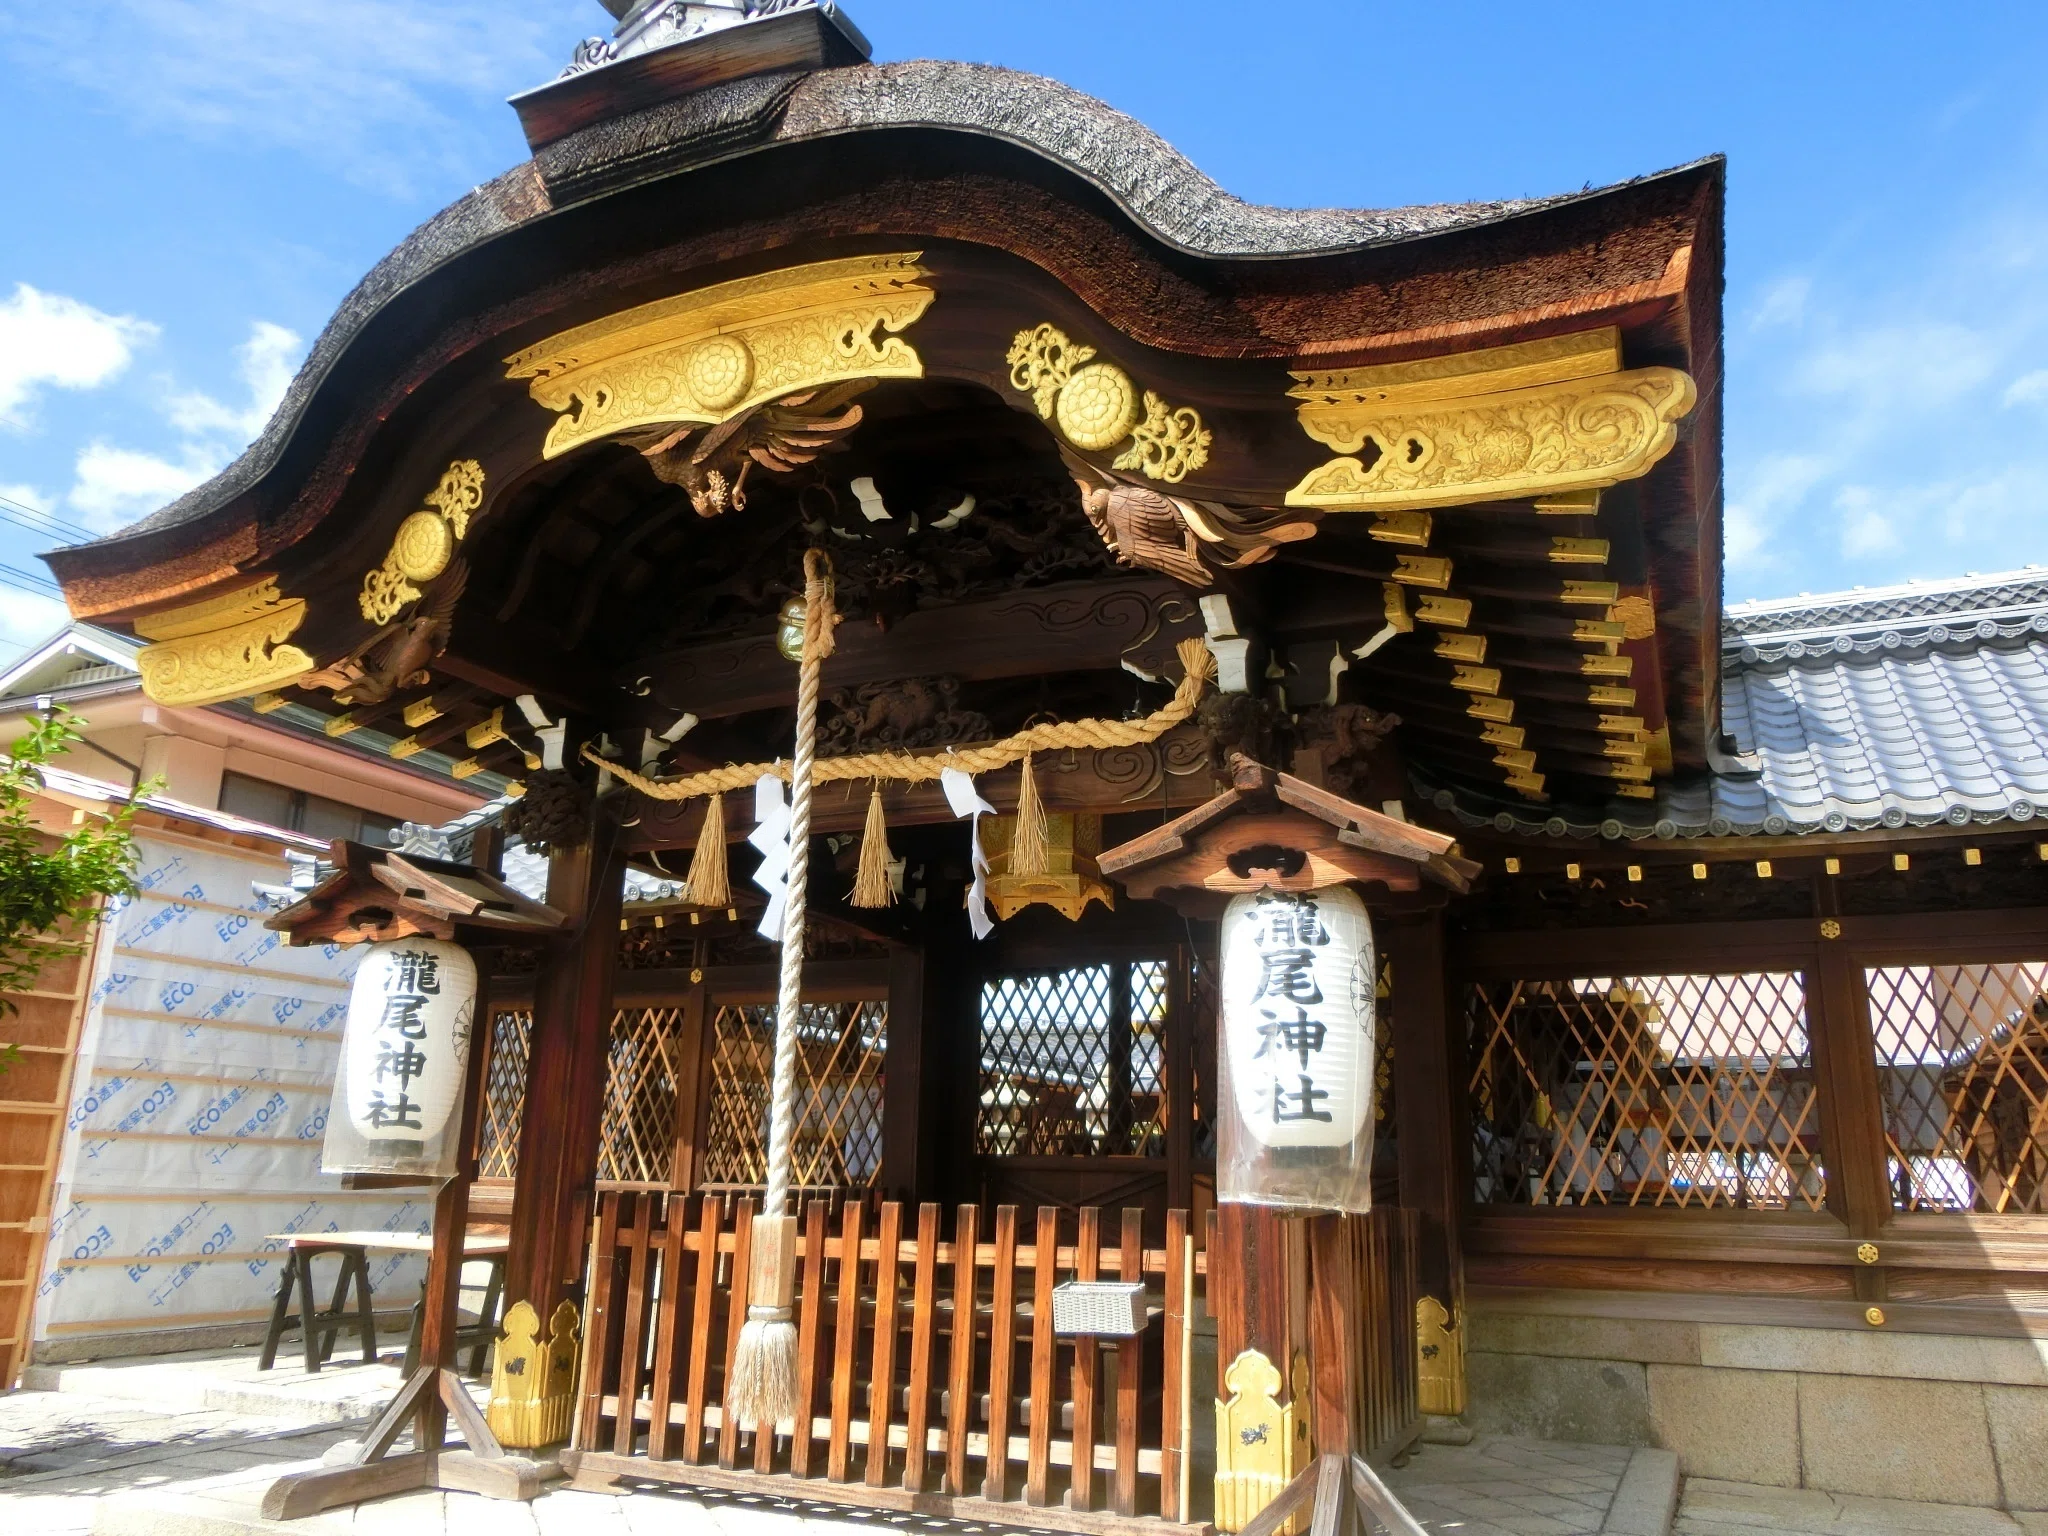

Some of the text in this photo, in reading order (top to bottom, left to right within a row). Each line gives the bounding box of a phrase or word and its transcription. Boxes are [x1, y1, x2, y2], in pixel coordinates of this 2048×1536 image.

[219, 914, 248, 942] ECO
[163, 983, 195, 1012] ECO
[276, 998, 302, 1025] ECO
[1243, 892, 1333, 1124] 瀧尾神社
[361, 949, 440, 1130] 瀧尾神社
[142, 1082, 175, 1114] ECO
[256, 1092, 285, 1123] ECO
[189, 1108, 220, 1136] ECO
[74, 1225, 111, 1260] ECO
[202, 1223, 233, 1255] ECO
